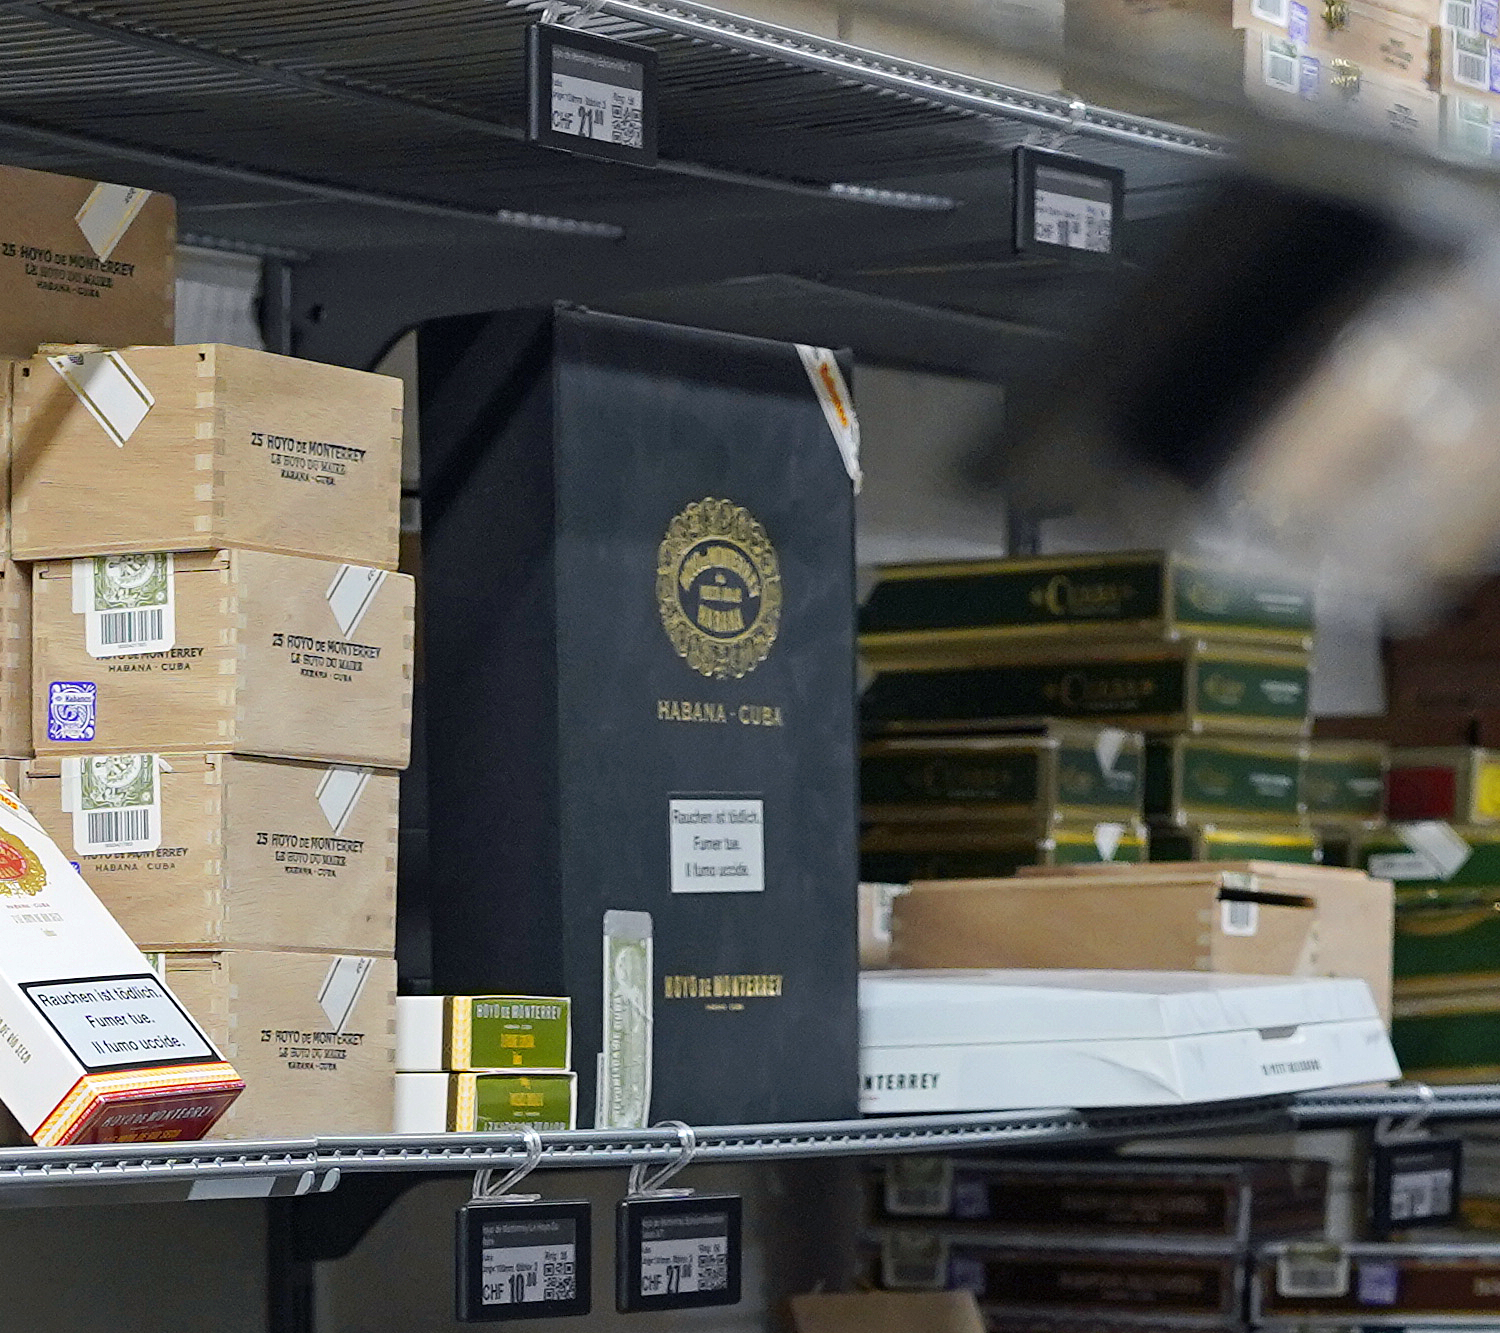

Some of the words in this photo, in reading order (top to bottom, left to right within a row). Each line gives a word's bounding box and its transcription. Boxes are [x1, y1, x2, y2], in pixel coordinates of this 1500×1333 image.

[251, 432, 264, 447] 25
[267, 434, 295, 452] HOYO
[308, 441, 367, 461] MONTERREY
[657, 700, 728, 724] HABANA
[738, 706, 783, 727] CUBA
[95, 862, 136, 873] HABANA
[147, 860, 177, 872] CUBA
[39, 989, 97, 1007] Rauchen
[100, 987, 115, 1003] ist
[116, 984, 162, 1004] tödlich.
[714, 975, 783, 997] MONTERREY
[87, 1014, 126, 1030] Fumer
[130, 1015, 155, 1028] tue.
[102, 1038, 135, 1053] fumo
[138, 1035, 186, 1051] uccide.
